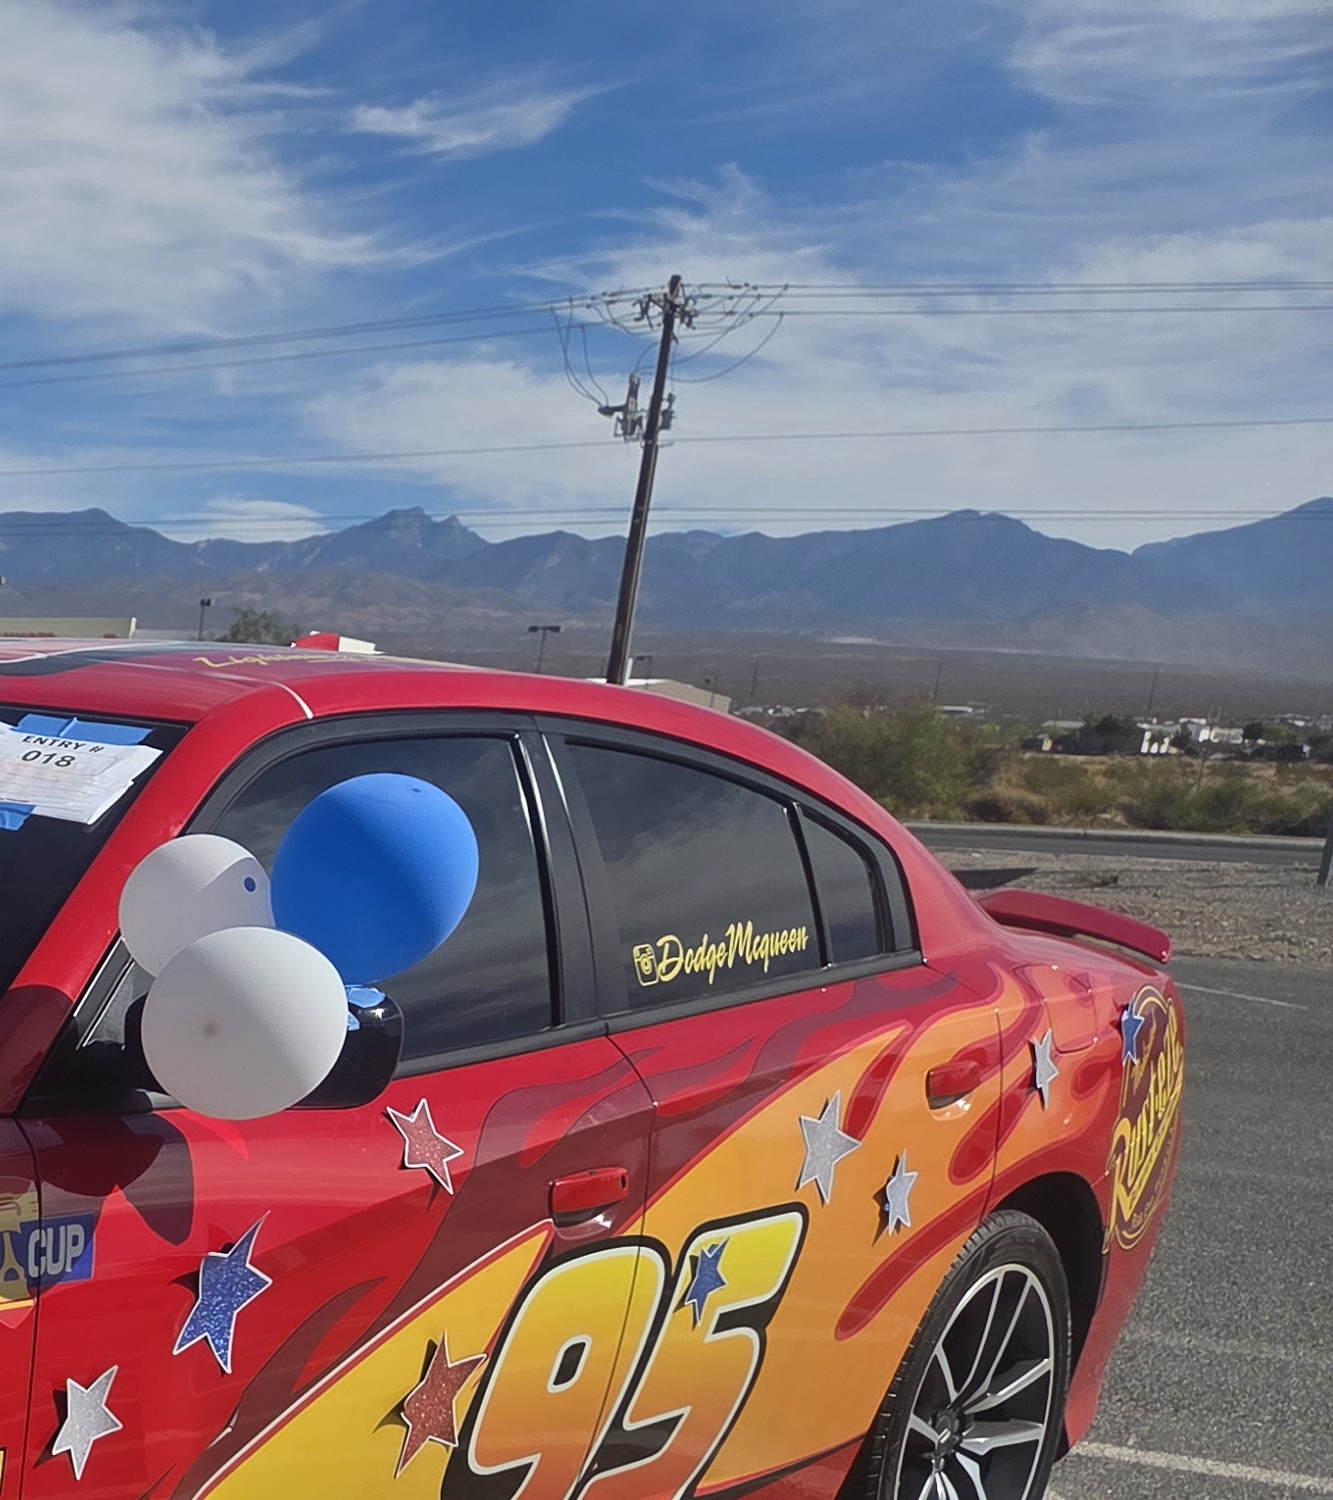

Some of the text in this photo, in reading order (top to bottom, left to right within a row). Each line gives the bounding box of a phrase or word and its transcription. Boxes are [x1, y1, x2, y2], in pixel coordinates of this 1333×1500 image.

[22, 735, 104, 753] ENTRY #
[21, 750, 75, 767] 018
[27, 1223, 85, 1278] CUP
